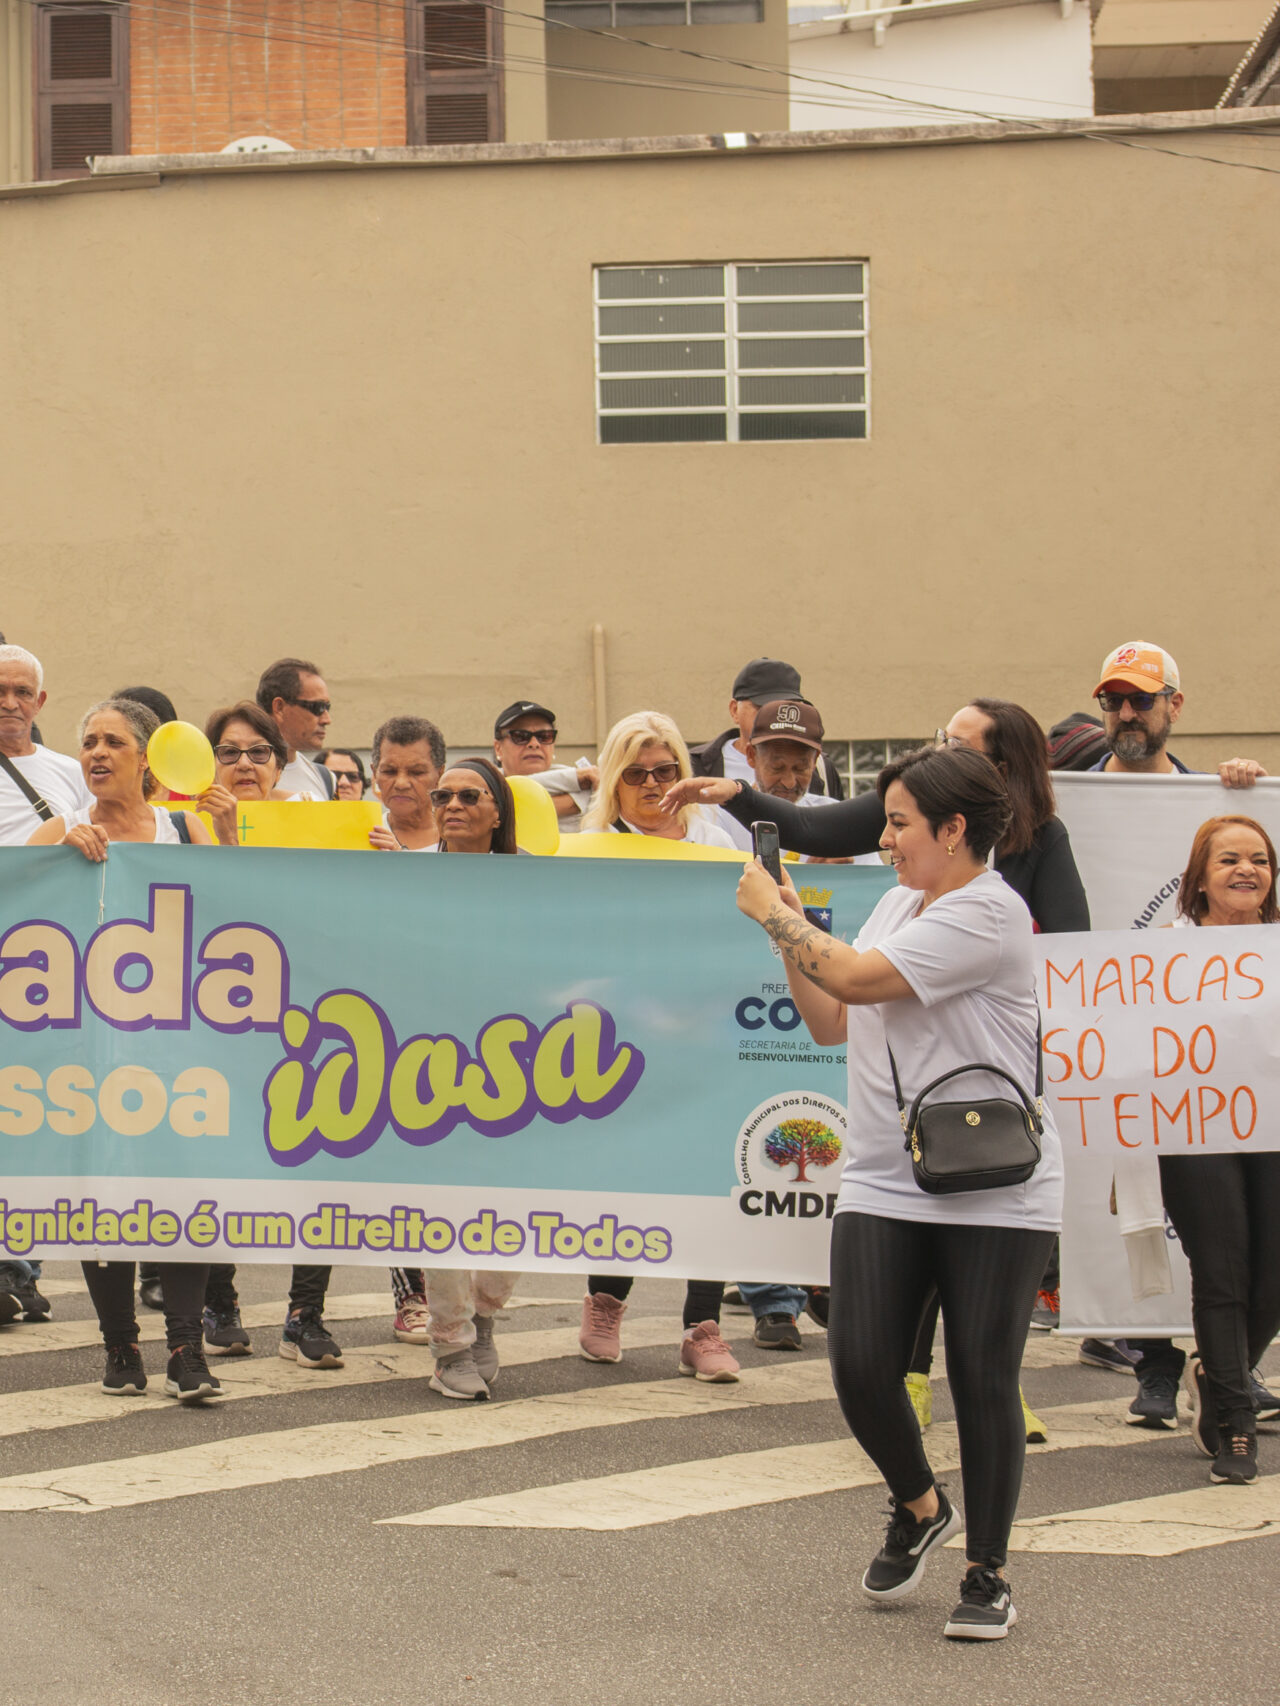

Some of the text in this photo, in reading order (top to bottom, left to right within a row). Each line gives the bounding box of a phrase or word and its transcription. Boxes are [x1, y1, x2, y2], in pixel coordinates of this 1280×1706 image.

[777, 704, 800, 723] 50
[761, 983, 791, 994] PREF
[1045, 952, 1264, 1009] MARCAS
[739, 1040, 811, 1051] SECRETARIA DE
[739, 1052, 833, 1064] DESENVOLVIMENTO
[1042, 1014, 1217, 1083] SÓ DO
[263, 989, 645, 1167] idosa
[1057, 1085, 1258, 1148] TEMPO
[184, 1200, 220, 1246] é
[222, 1210, 295, 1249] um
[298, 1202, 456, 1253] direito
[458, 1208, 526, 1256] de
[528, 1211, 672, 1264] Todos
